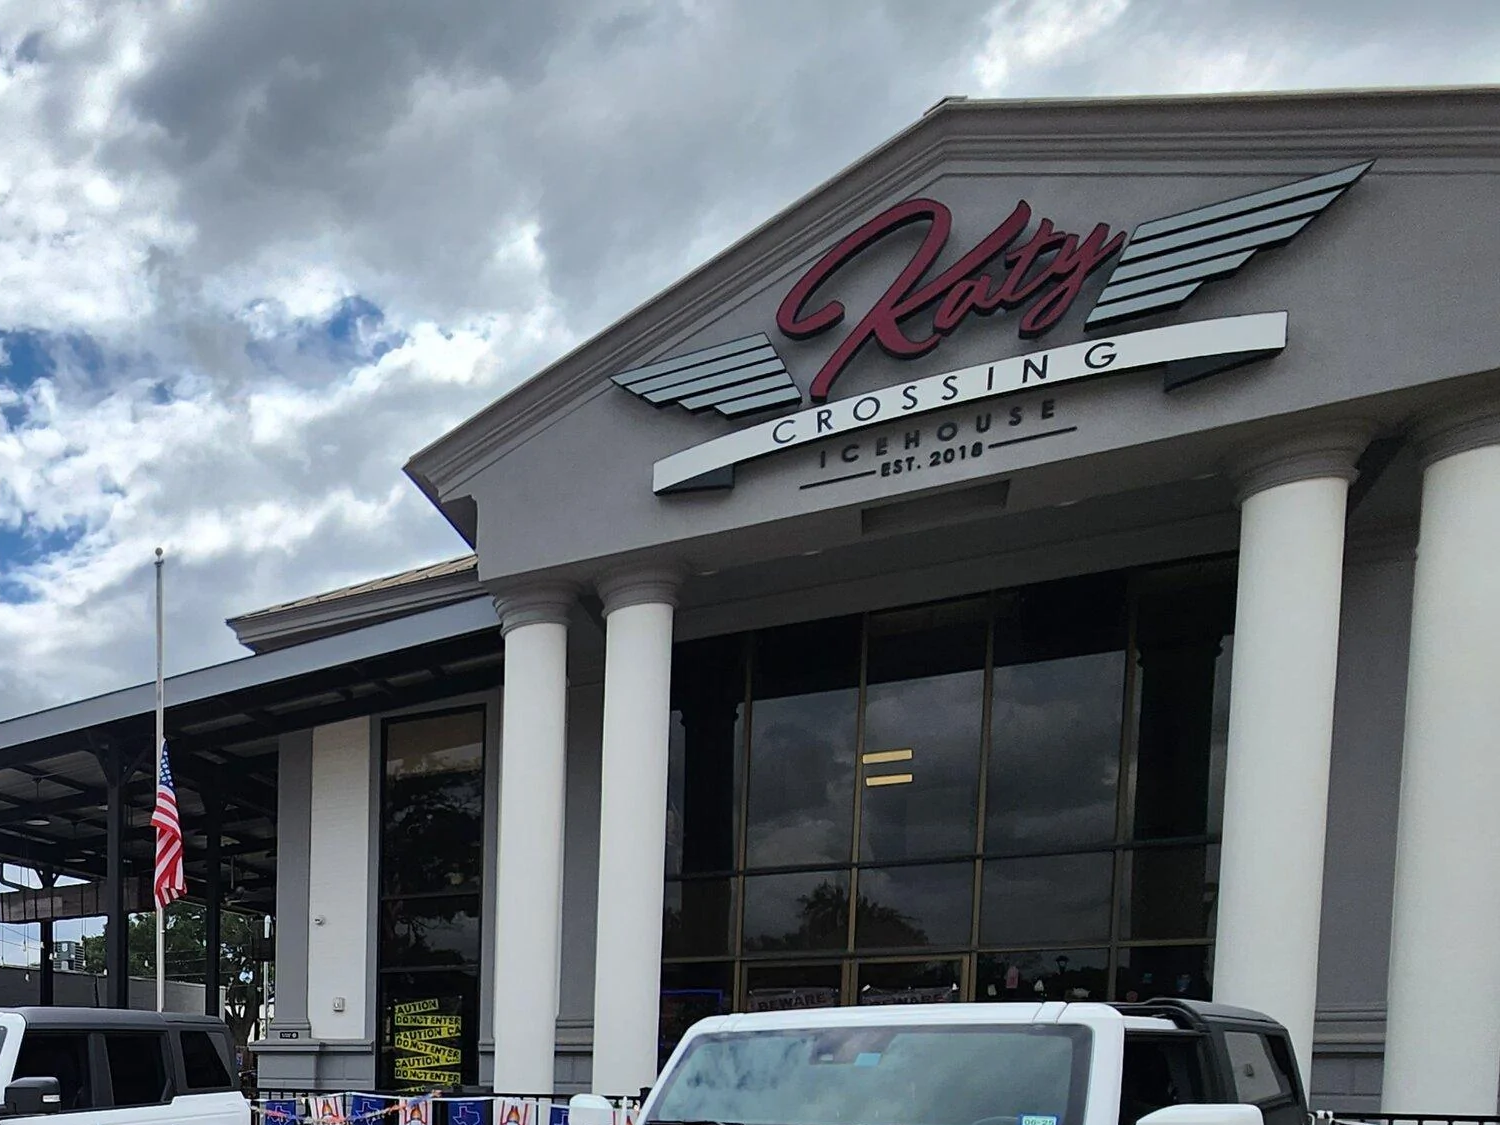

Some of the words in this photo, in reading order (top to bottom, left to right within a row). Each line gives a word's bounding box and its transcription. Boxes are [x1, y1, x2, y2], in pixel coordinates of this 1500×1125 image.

[776, 198, 1128, 402] Katy
[771, 341, 1118, 445] CROSSING
[819, 399, 1056, 469] ICEHOUSE
[880, 457, 922, 479] EST.
[929, 442, 984, 469] 2018
